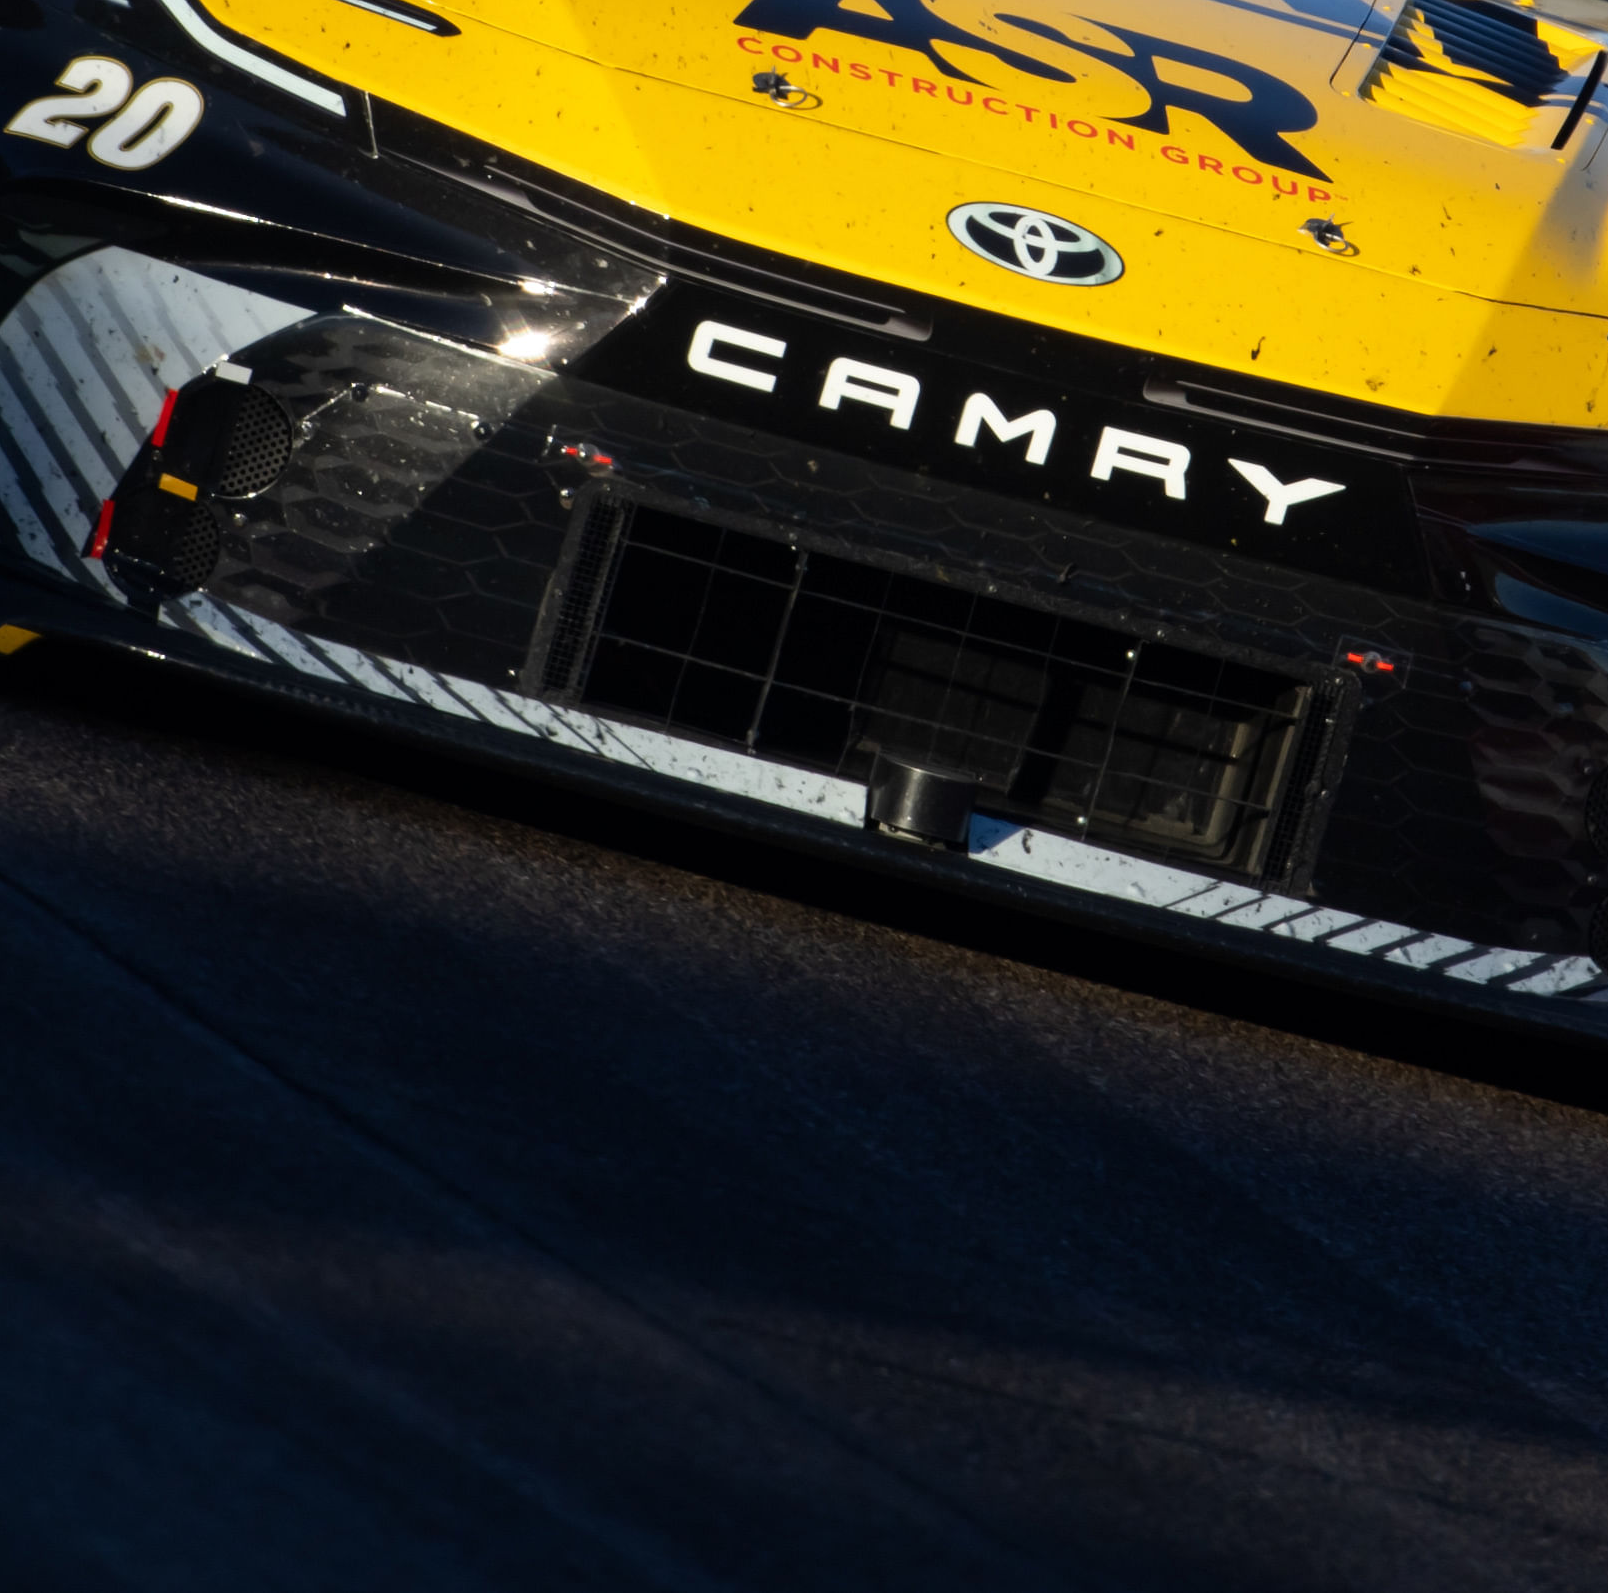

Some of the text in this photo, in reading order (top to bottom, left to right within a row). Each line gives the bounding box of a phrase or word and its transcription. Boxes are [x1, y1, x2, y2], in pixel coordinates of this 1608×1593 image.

[3, 55, 205, 171] 20
[736, 35, 1333, 203] CONSTRUCTION GROUP
[687, 319, 1347, 525] CAMRY
